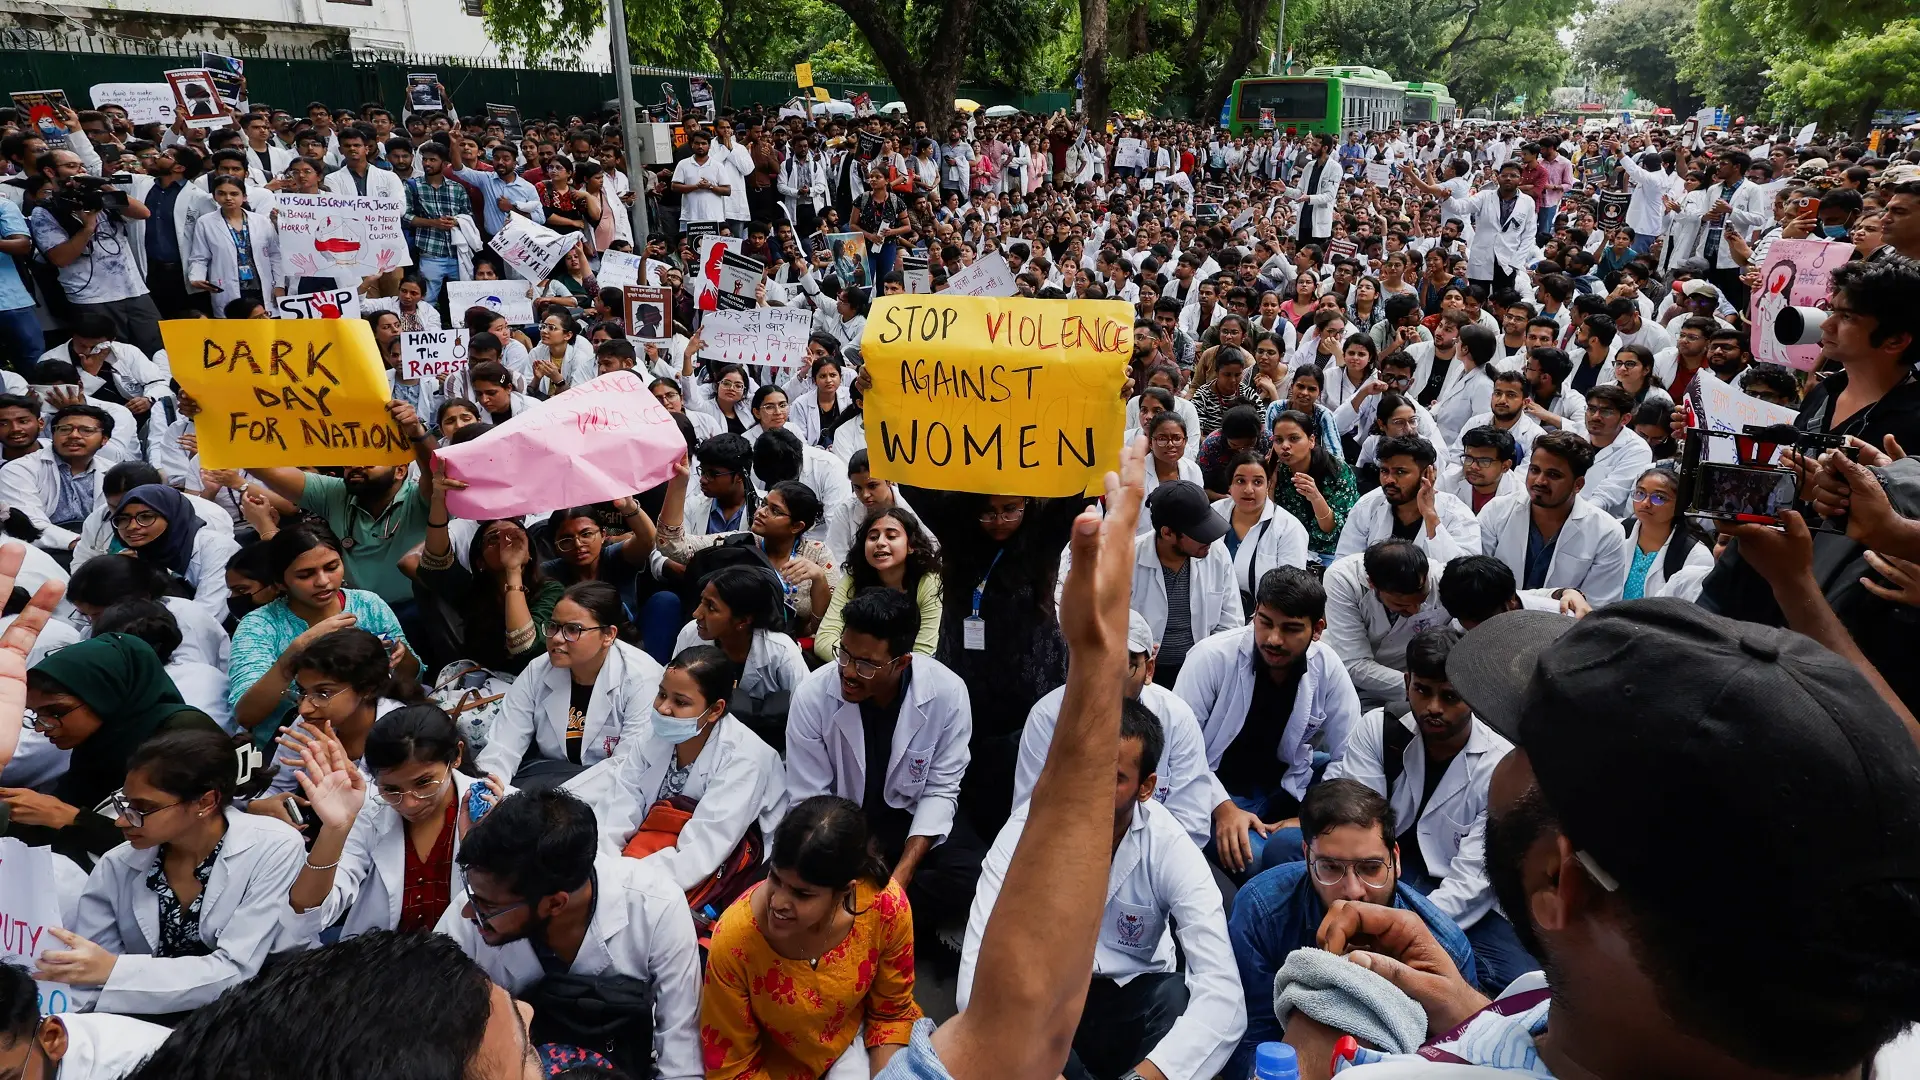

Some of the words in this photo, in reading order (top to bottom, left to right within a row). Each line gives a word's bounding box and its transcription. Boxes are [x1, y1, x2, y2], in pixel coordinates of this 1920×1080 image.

[294, 196, 316, 207] SOUL
[281, 223, 311, 234] HORROR
[280, 291, 352, 319] STP
[408, 332, 447, 346] HANG
[879, 305, 958, 344] STOP
[986, 310, 1129, 354] VIOLENCE
[203, 338, 340, 386] DARK
[416, 348, 438, 360] The
[408, 360, 468, 378] RAPIST
[900, 358, 1043, 402] AGAINST
[252, 385, 332, 416] DAY
[230, 412, 288, 451] FOR
[300, 418, 410, 452] NATION
[880, 419, 1096, 471] WOMEN
[0, 912, 43, 958] UTY
[1117, 940, 1142, 948] MAMC
